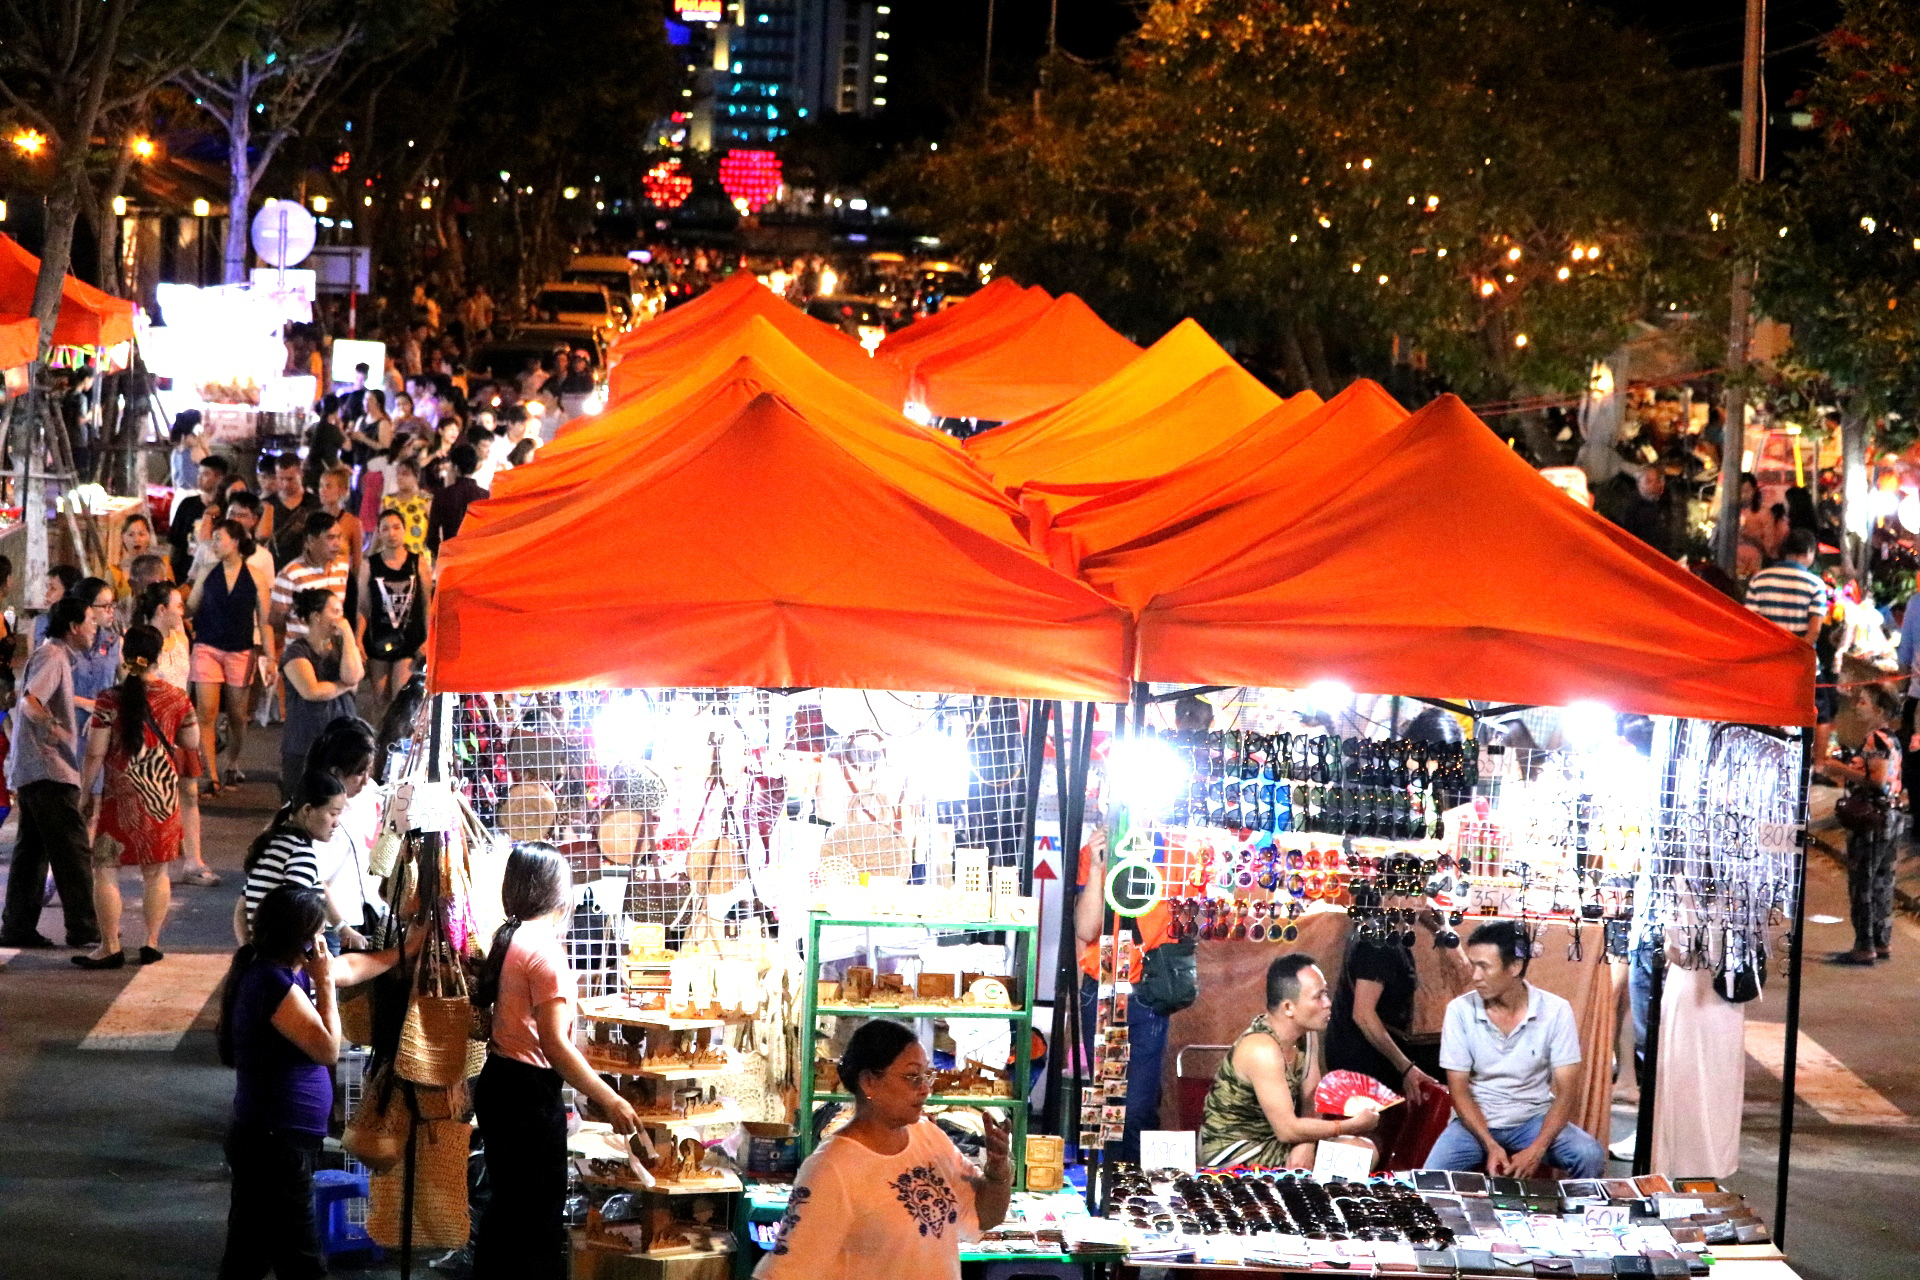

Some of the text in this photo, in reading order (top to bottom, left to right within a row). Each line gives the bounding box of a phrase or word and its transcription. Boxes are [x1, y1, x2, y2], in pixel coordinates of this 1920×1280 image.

[1762, 825, 1797, 847] 80K
[1472, 890, 1512, 910] 35K
[1585, 1209, 1625, 1226] 60K
